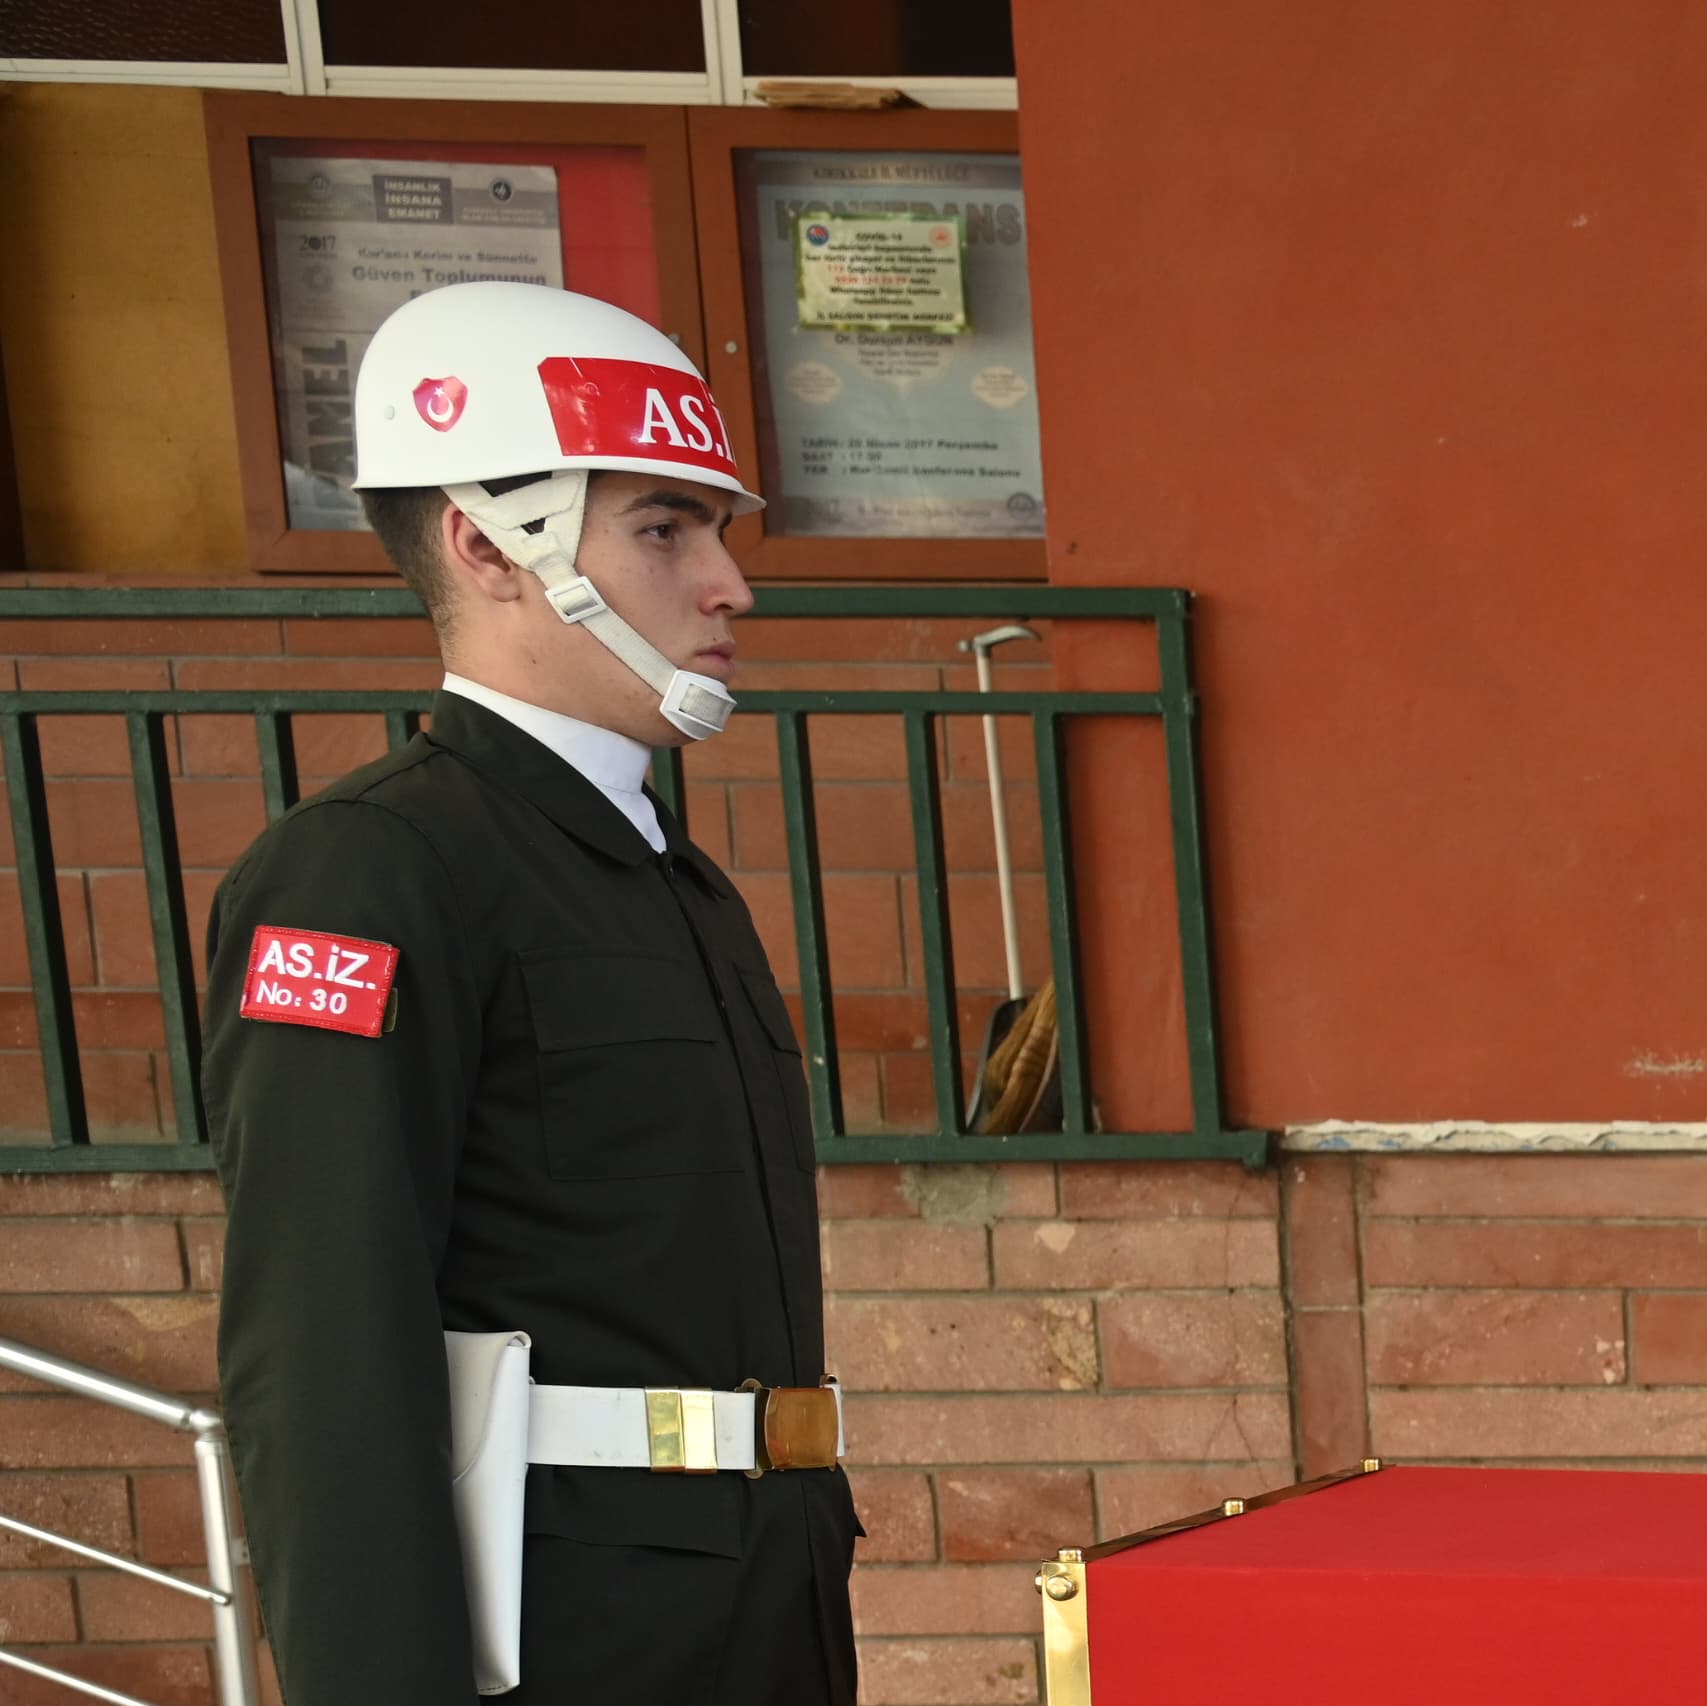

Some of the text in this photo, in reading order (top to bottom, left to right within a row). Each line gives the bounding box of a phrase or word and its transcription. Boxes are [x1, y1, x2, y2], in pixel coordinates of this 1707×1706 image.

[352, 266, 415, 282] Güven
[638, 387, 736, 464] AS.İ
[256, 980, 348, 1015] No: 30
